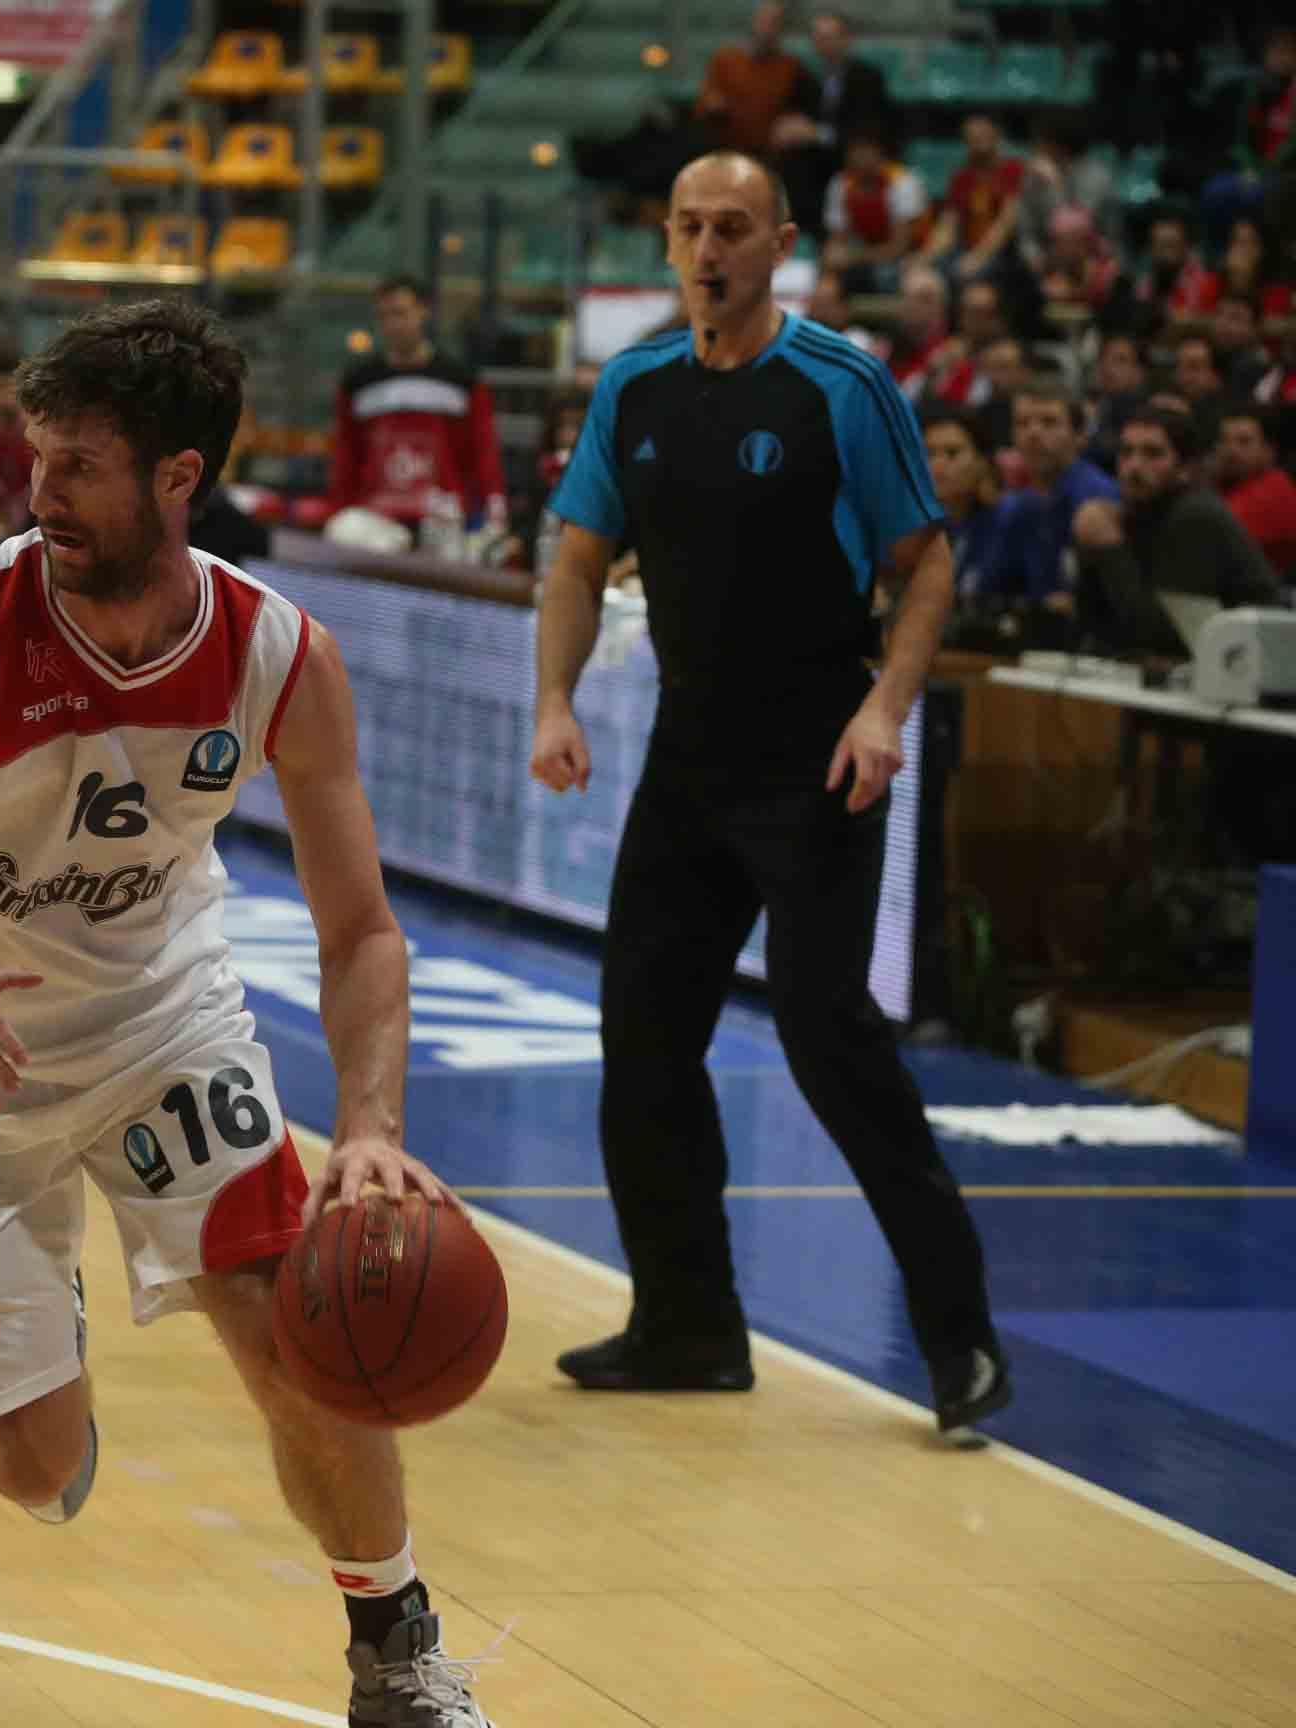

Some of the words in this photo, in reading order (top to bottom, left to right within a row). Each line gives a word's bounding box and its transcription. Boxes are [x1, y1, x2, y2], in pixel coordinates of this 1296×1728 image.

[23, 690, 88, 722] sporta
[67, 771, 149, 842] 16
[161, 1067, 271, 1166] 16
